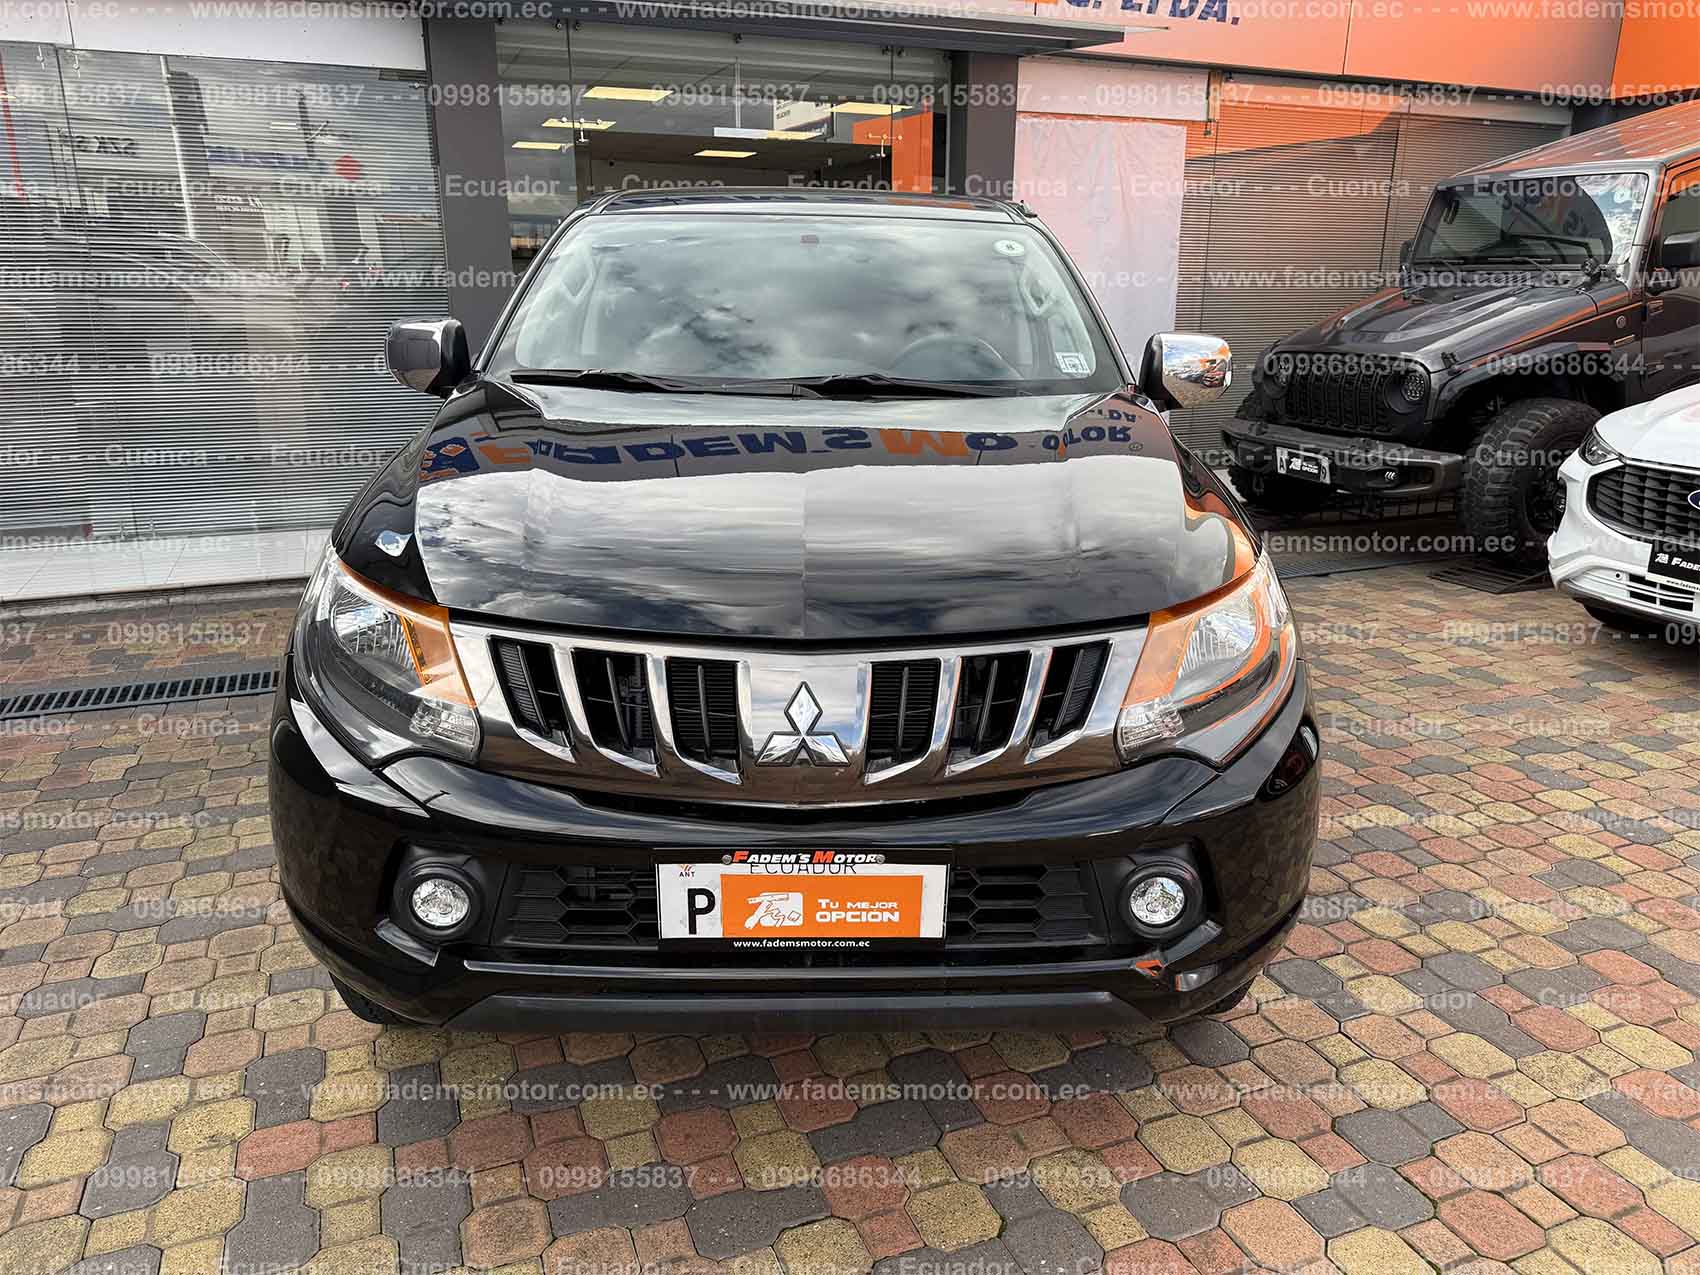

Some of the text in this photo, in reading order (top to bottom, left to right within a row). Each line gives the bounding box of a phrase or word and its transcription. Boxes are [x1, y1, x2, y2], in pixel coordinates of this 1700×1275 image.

[812, 851, 877, 864] MOTOR
[750, 863, 856, 875] ECUADOR
[687, 888, 716, 935] P
[847, 901, 899, 910] MEJOR
[733, 939, 870, 949] www.fademsmotor.com.ec
